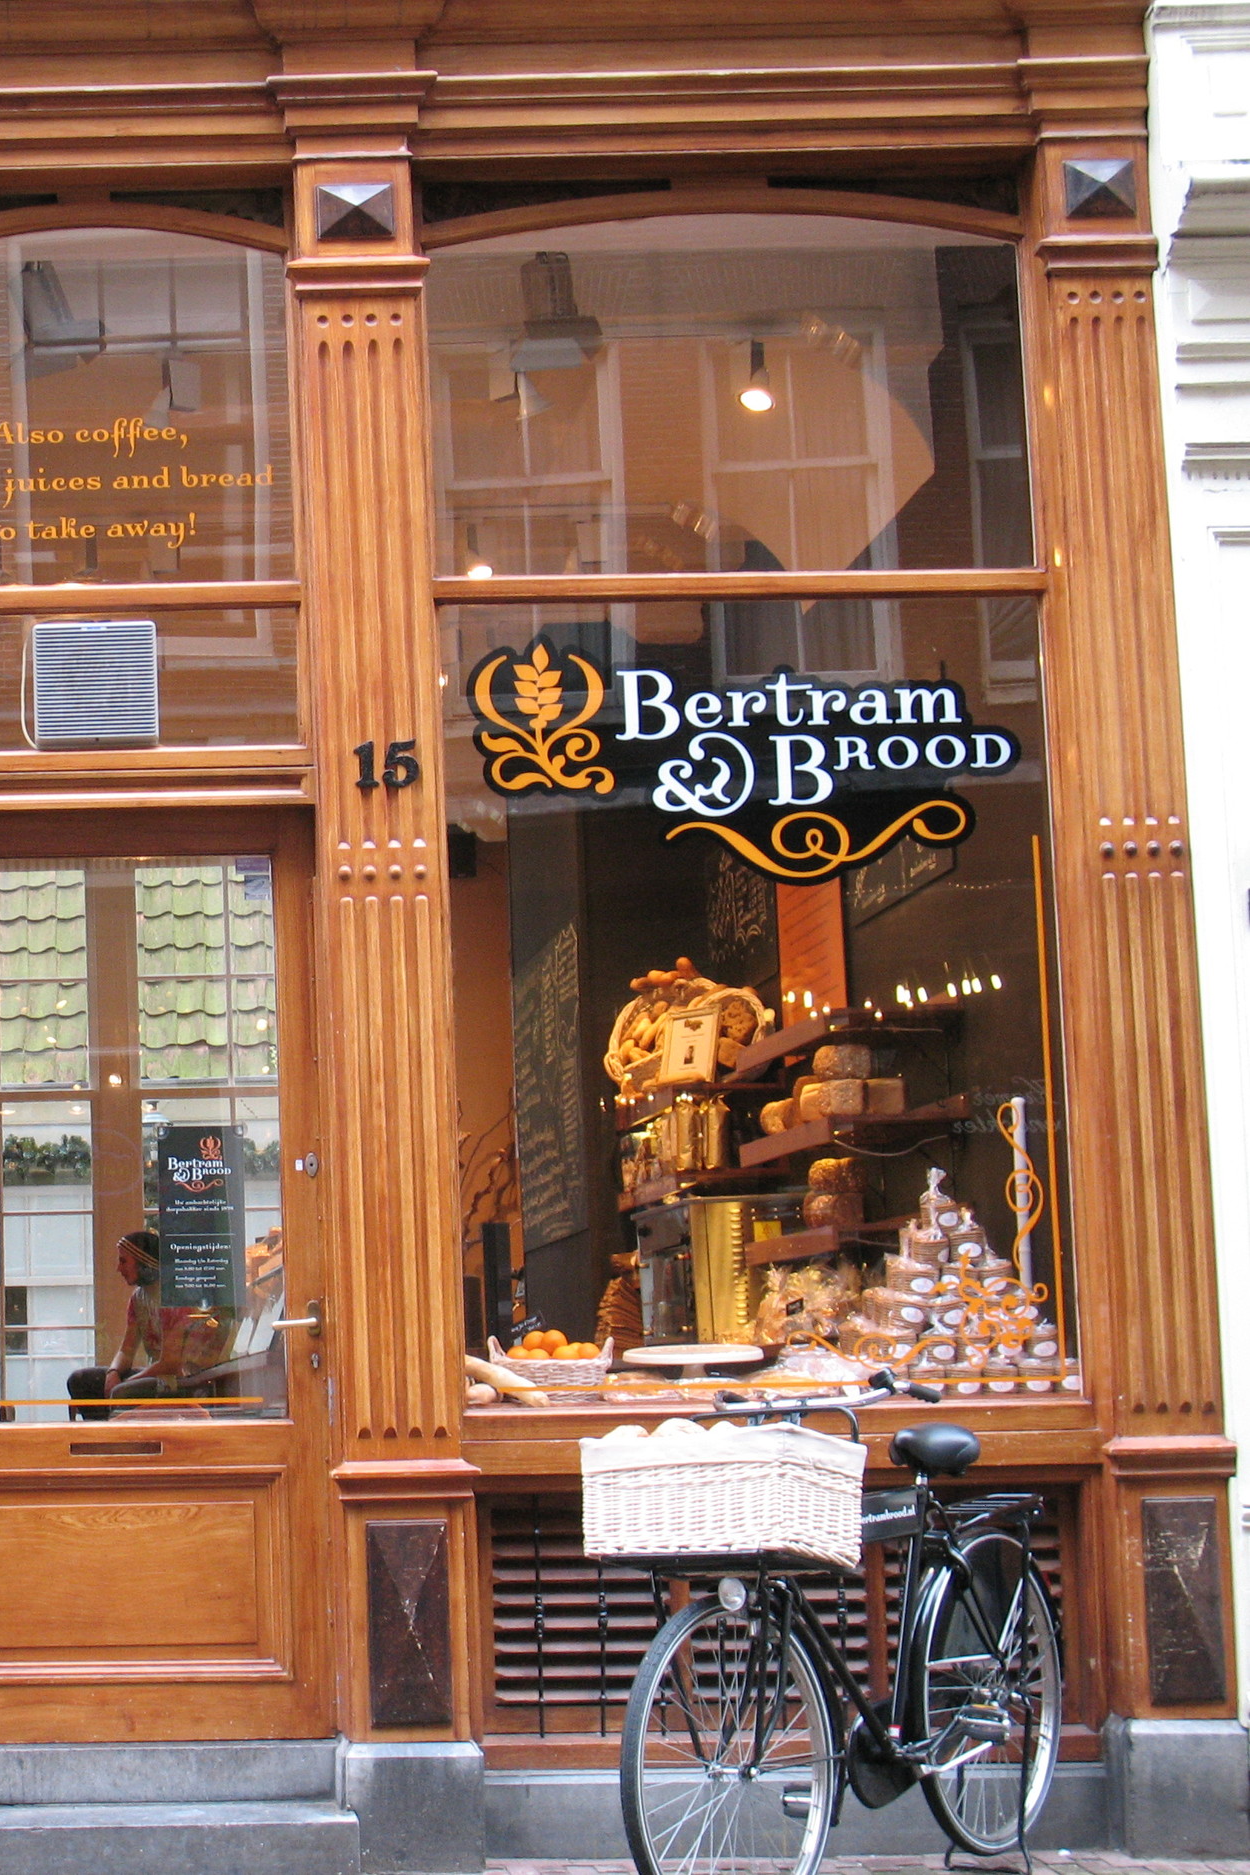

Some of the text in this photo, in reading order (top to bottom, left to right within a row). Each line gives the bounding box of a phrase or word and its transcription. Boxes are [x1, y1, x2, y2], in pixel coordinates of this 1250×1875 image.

[75, 417, 189, 458] coffee,
[3, 467, 102, 508] juices
[112, 466, 170, 490] and
[176, 463, 274, 487] bread
[26, 516, 96, 540] take
[106, 511, 197, 549] away!
[615, 669, 962, 742] Bertram
[353, 738, 420, 790] 15
[651, 730, 754, 817] &
[167, 1156, 223, 1171] Bertram
[172, 1167, 191, 1183] &
[861, 1504, 916, 1525] ertrambrood.nl
